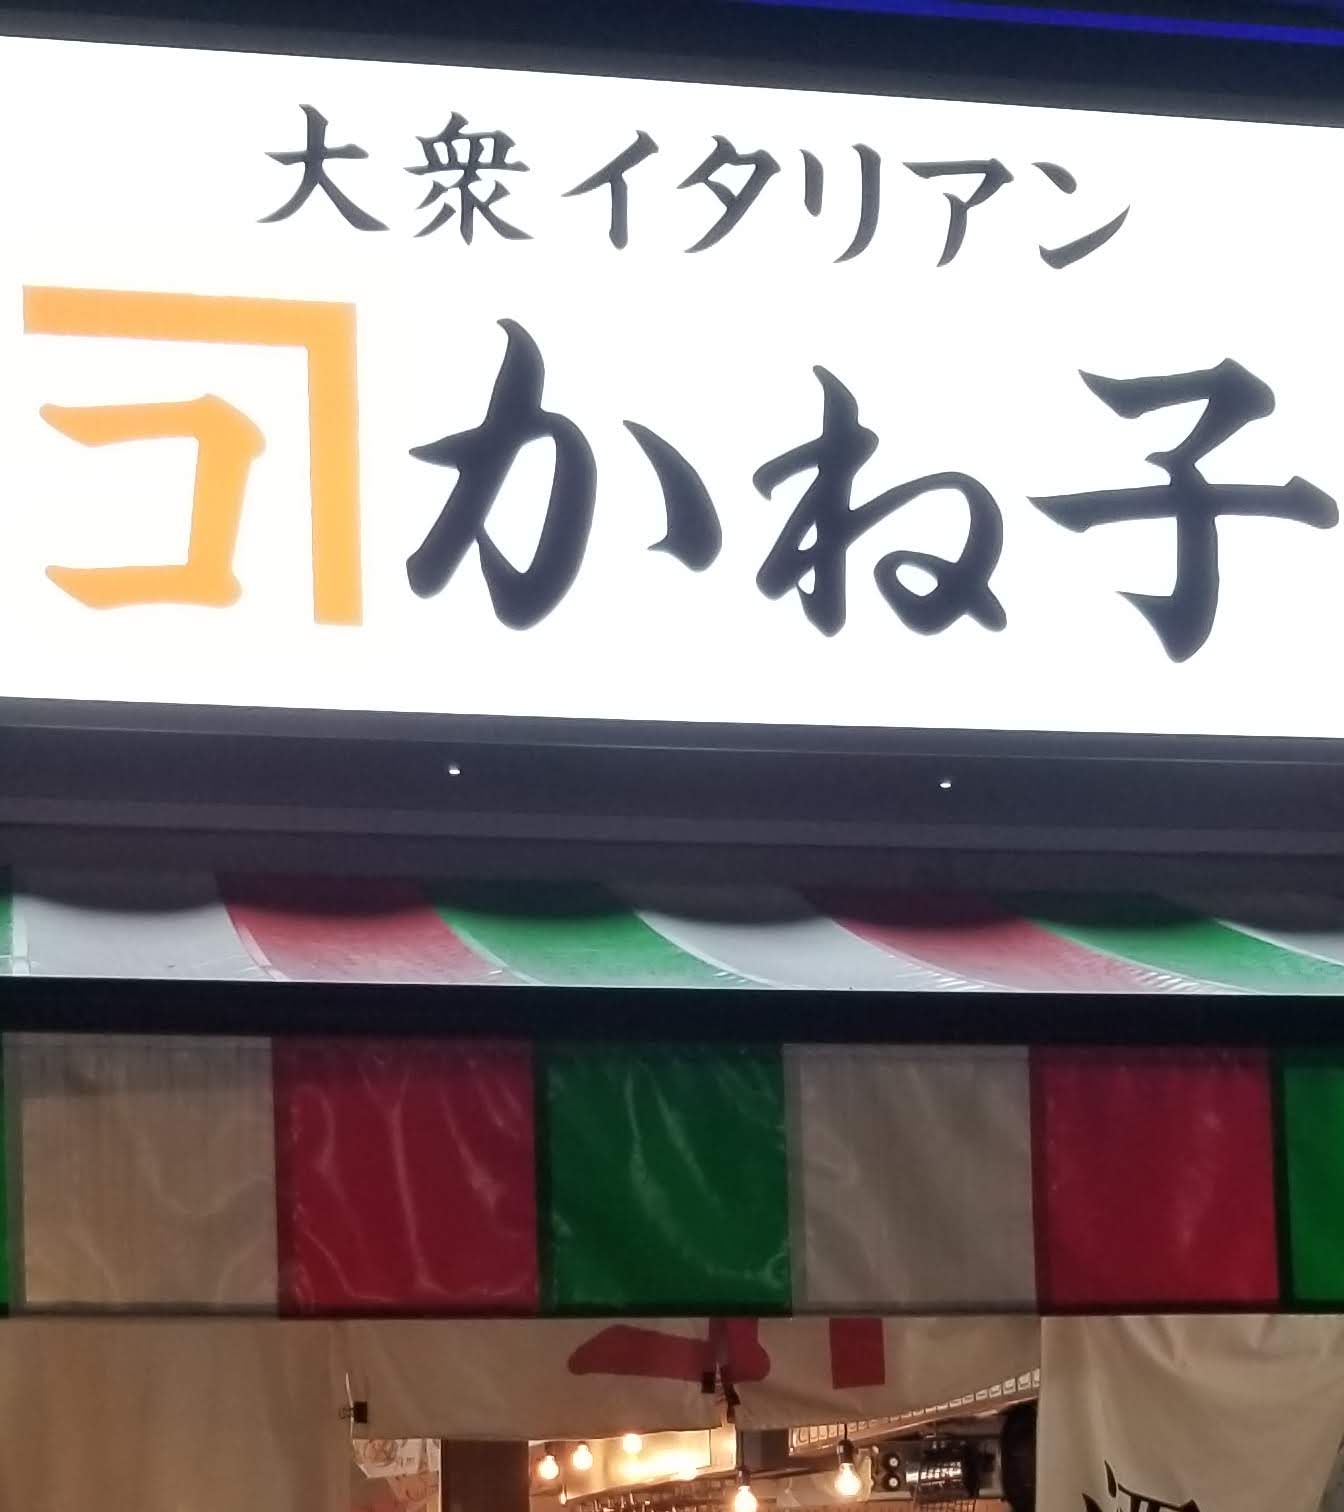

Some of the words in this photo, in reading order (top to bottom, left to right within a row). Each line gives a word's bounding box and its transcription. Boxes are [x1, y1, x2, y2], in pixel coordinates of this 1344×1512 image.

[258, 104, 1131, 271] 大衆イタリアン
[406, 317, 1341, 663] かね子
